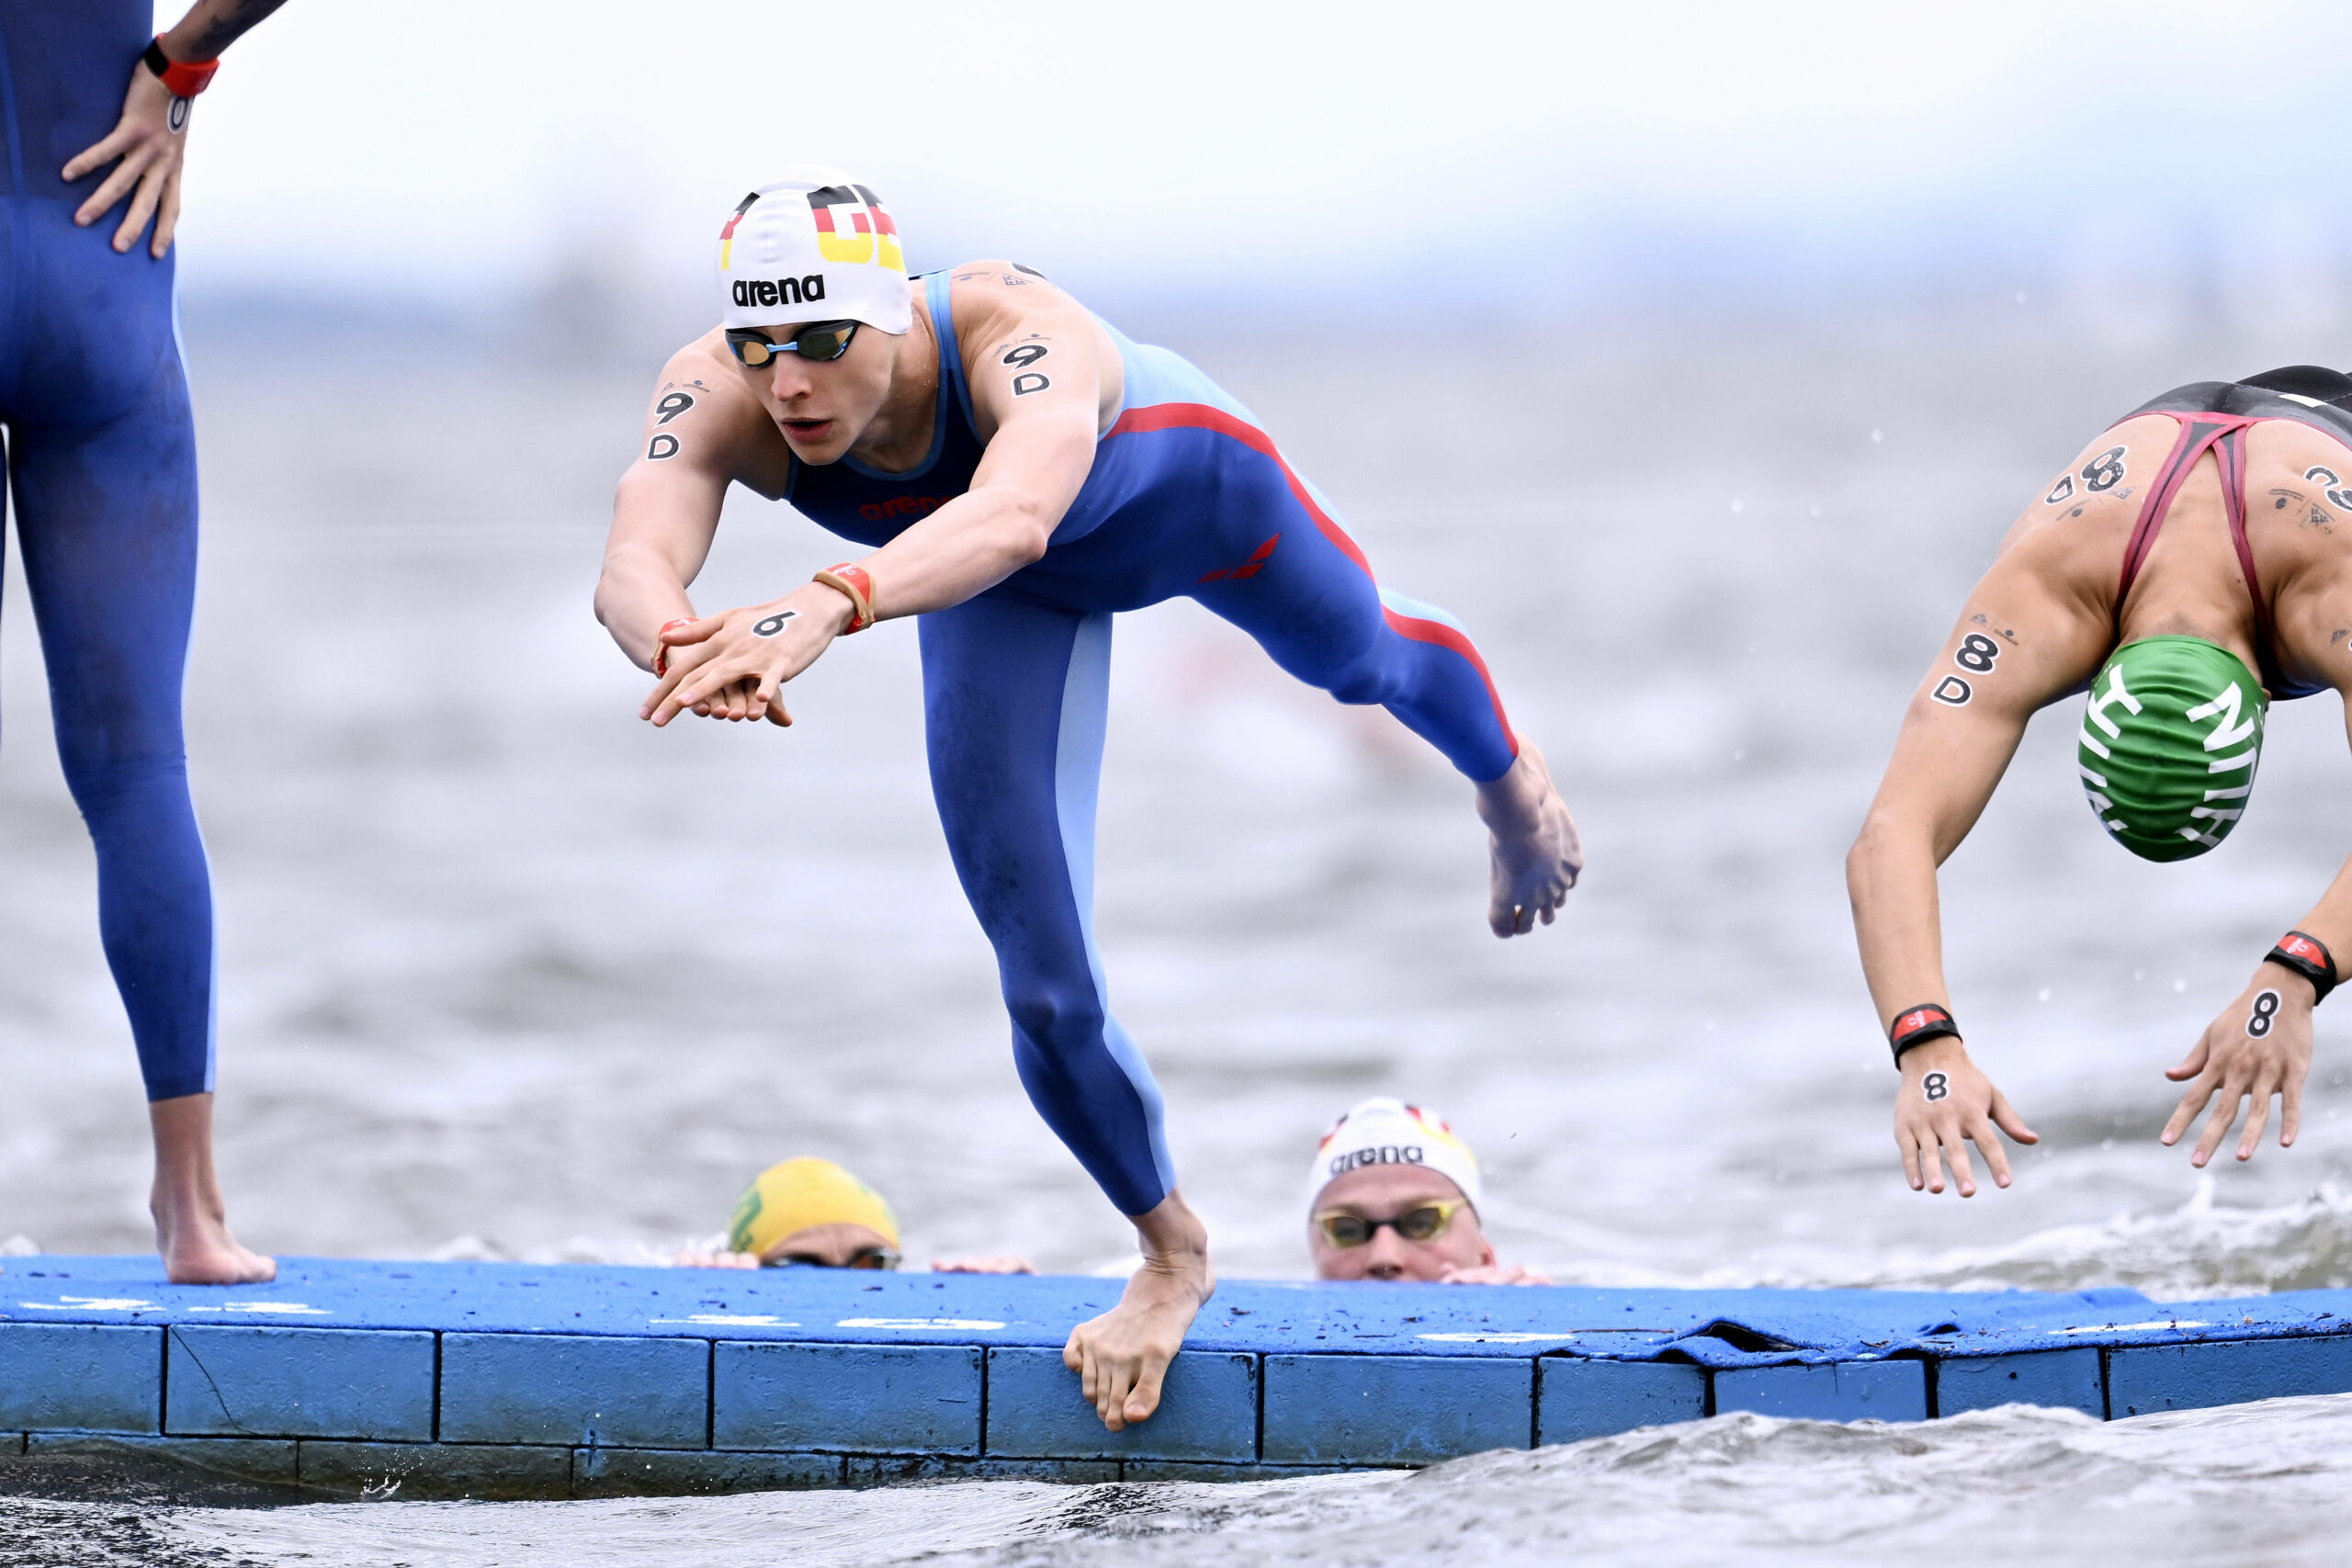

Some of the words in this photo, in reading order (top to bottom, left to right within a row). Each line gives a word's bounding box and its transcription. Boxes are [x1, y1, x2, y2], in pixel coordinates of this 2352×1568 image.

[732, 274, 825, 307] arena
[1003, 344, 1048, 370] 9
[1013, 373, 1049, 396] D
[655, 392, 695, 426] 9
[647, 434, 680, 459] D
[2081, 446, 2126, 491] 8
[859, 496, 956, 521] aren
[1955, 633, 1999, 672] 8
[1932, 675, 1971, 705] D
[2247, 991, 2279, 1037] 8
[1922, 1072, 1948, 1101] 8
[1330, 1145, 1424, 1174] arena
